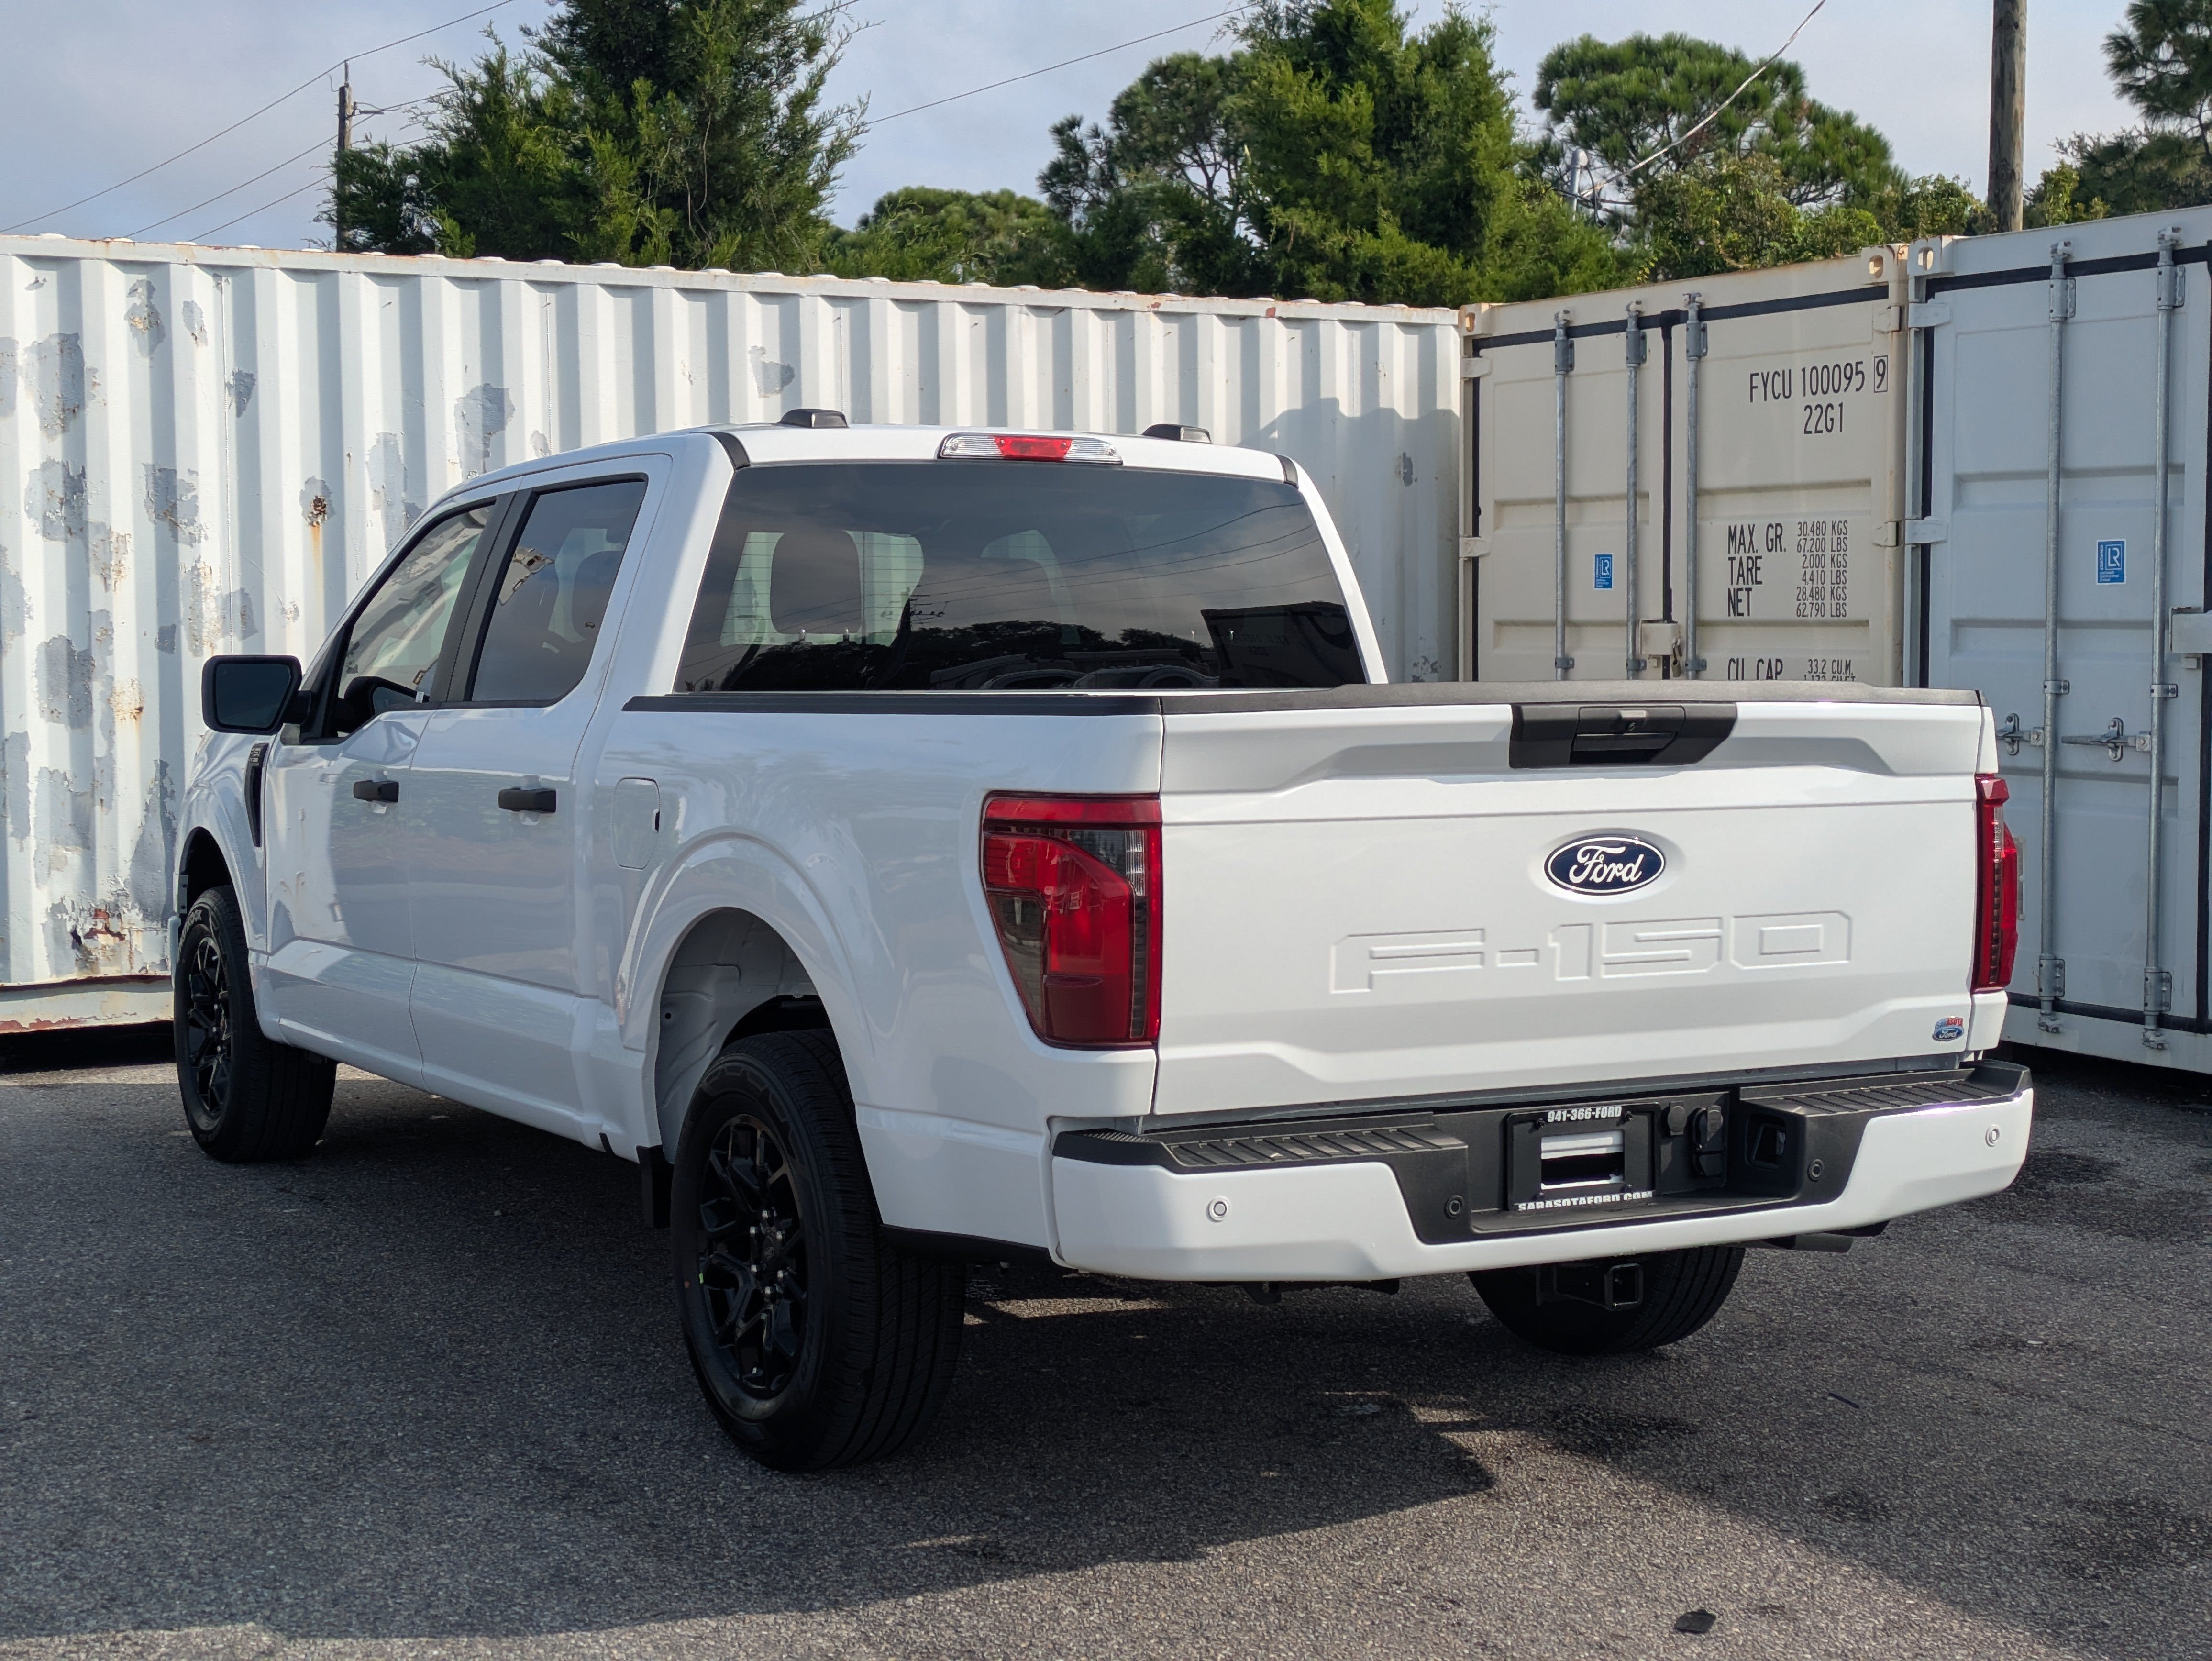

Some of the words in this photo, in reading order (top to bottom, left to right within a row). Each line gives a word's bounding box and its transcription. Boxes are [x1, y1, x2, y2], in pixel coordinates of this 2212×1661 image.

[1749, 369, 1792, 403] FYCU
[1801, 361, 1865, 397] 100095
[1876, 359, 1886, 389] 9
[1803, 402, 1844, 435] 22G1
[1728, 524, 1758, 554] MAX.
[1766, 523, 1786, 553] GR.
[1797, 521, 1826, 537] 30.480
[1831, 520, 1848, 536] KGS
[1797, 537, 1826, 553] 67.200
[1831, 537, 1848, 553] LBS
[1601, 559, 1610, 576] LR
[2108, 547, 2120, 567] LR
[1728, 555, 1763, 586] TARE
[1802, 554, 1826, 569] 2.000
[1830, 553, 1847, 569] KGS
[1802, 569, 1825, 585] 4.410
[1830, 569, 1847, 585] LBS
[1727, 587, 1753, 617] NET
[1796, 586, 1825, 601] 28.480
[1830, 586, 1847, 601] KGS
[1796, 602, 1825, 618] 62.790
[1830, 602, 1847, 618] LBS
[1756, 658, 1783, 680] CAP
[1808, 659, 1826, 675] 33.2
[1569, 844, 1643, 885] Ford
[1329, 910, 1852, 994] F-150
[1547, 1106, 1623, 1123] 941-366-FORD
[1518, 1191, 1653, 1211] SARASOTAFORDCOM
